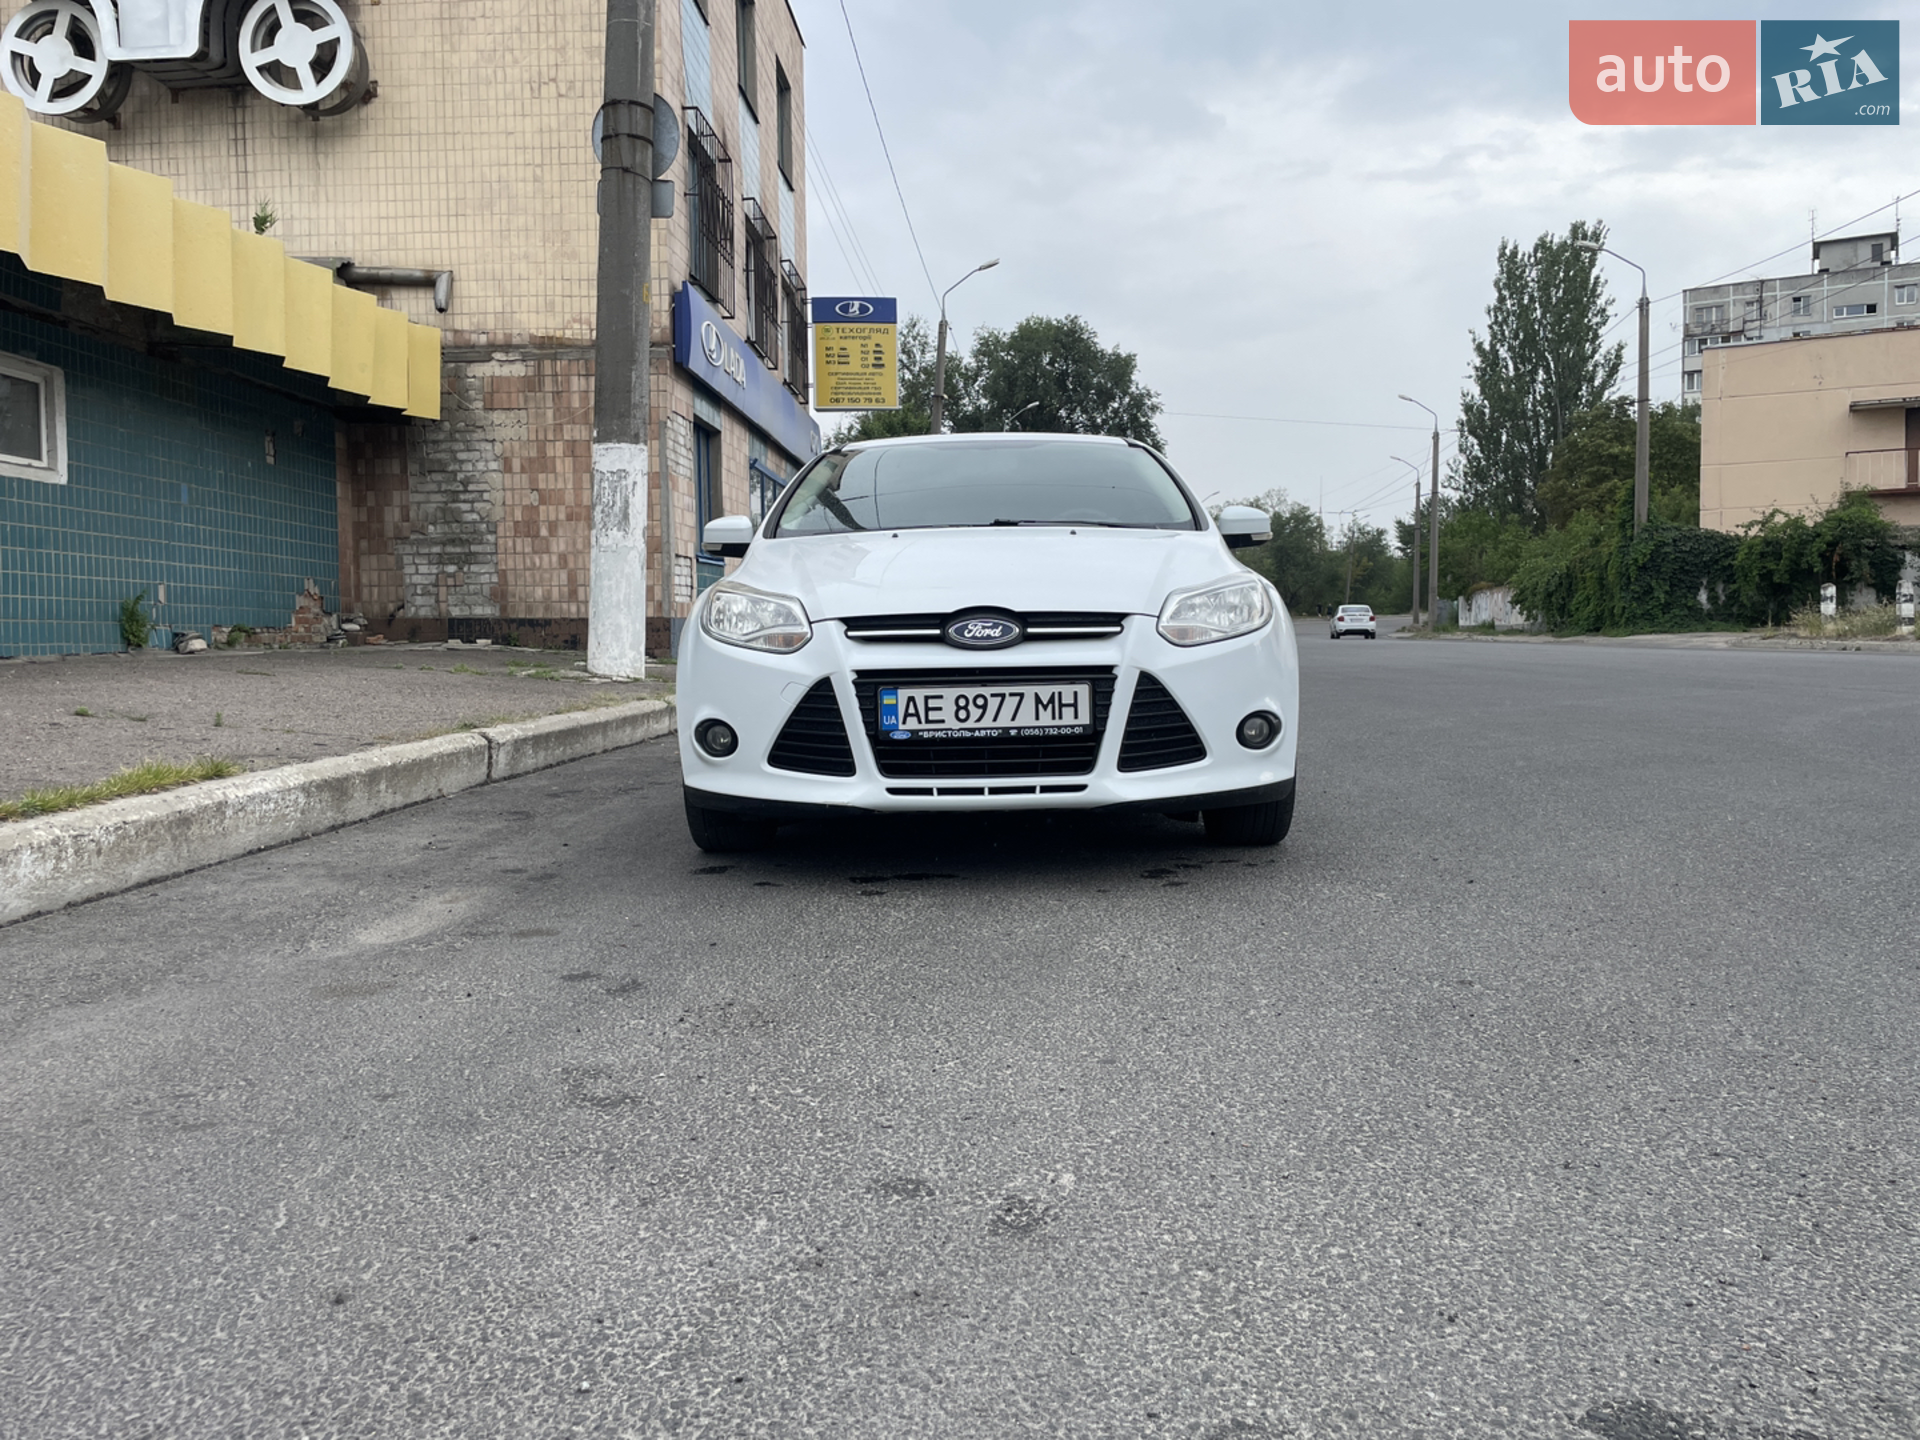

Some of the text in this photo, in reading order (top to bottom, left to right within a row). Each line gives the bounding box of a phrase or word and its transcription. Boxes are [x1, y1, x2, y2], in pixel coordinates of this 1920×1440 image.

[723, 342, 746, 390] LADA
[964, 622, 1002, 638] Ford
[902, 690, 1079, 725] AE 8977 MH
[883, 716, 897, 725] UA
